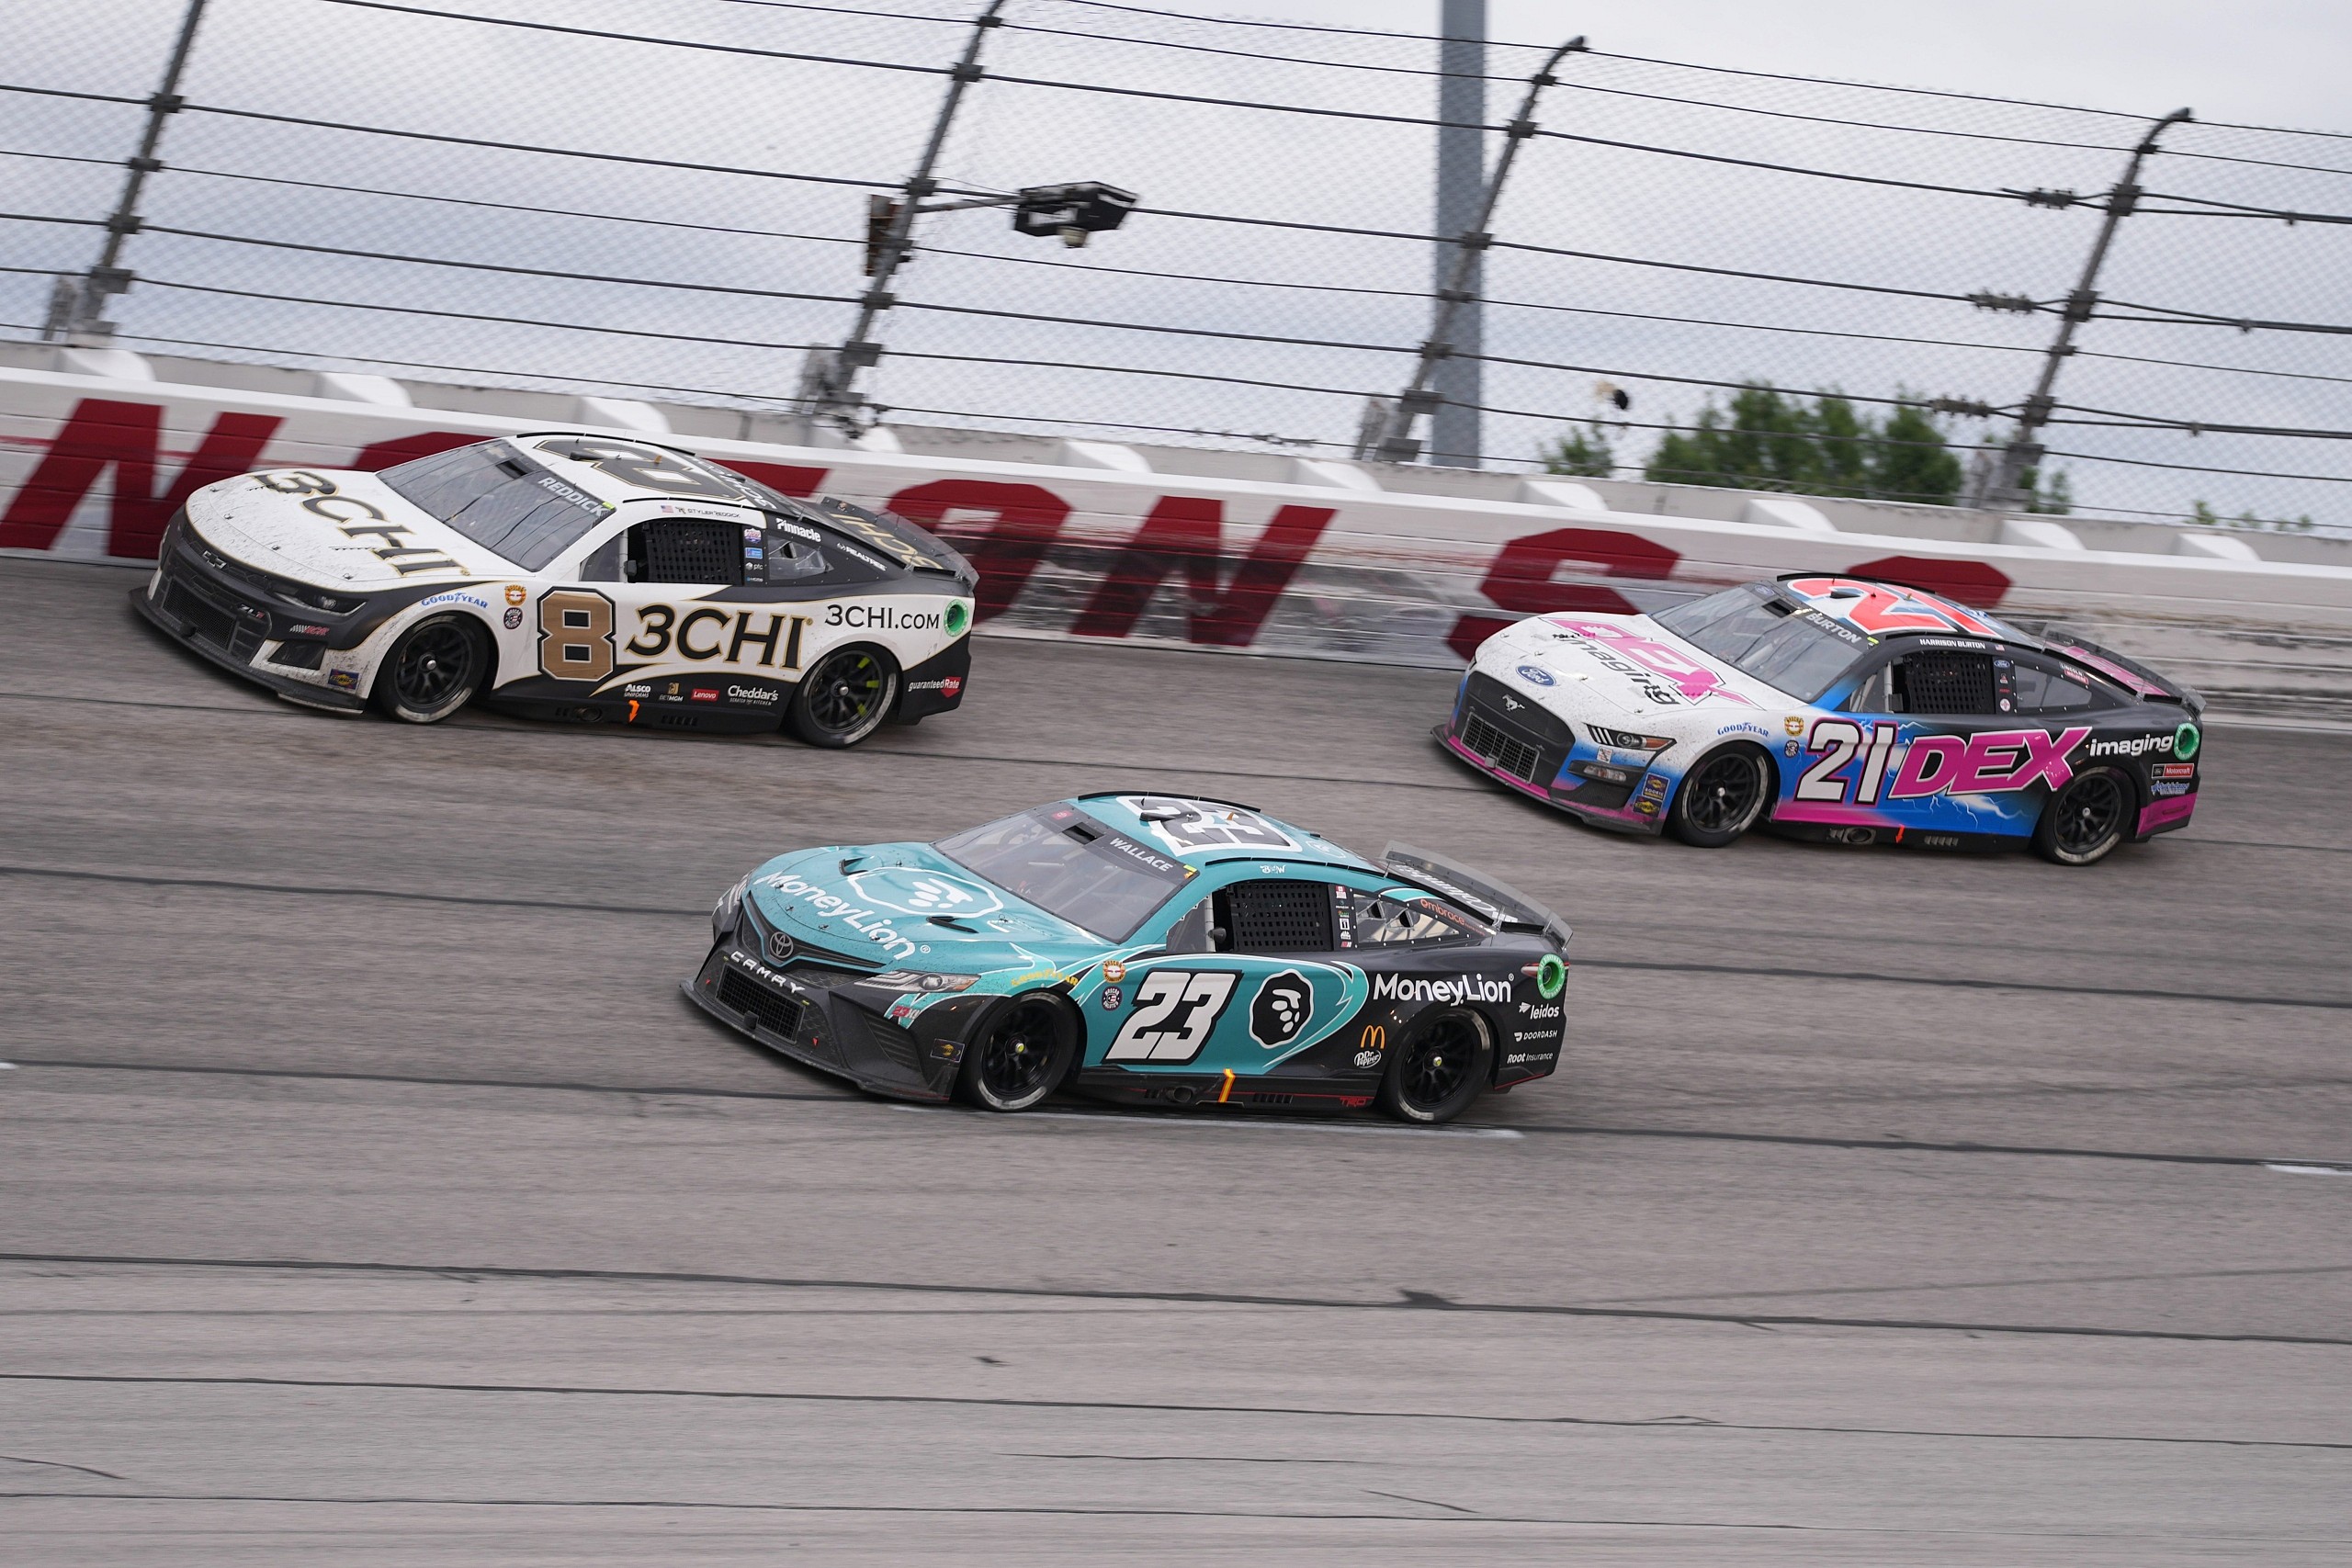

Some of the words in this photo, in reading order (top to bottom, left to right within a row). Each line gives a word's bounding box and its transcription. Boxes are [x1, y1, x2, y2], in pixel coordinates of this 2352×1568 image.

[537, 477, 609, 516] REDDICK
[248, 470, 469, 577] 3CHI
[775, 517, 821, 543] Pinnacle
[844, 546, 887, 571] REALTREE
[421, 592, 488, 608] GOODYEAR
[1787, 578, 2005, 640] 21
[825, 604, 940, 629] 3CHI.COM
[1806, 613, 1861, 643] BURTON
[537, 587, 616, 682] 8
[624, 603, 808, 671] 3CHI
[1919, 638, 1957, 648] HARRISON
[1957, 641, 1985, 649] BURTON
[625, 683, 650, 693] ALSCO
[659, 694, 684, 702] BETMGM
[693, 691, 717, 699] Lenovo
[728, 684, 779, 702] Cheddar's
[1717, 722, 1770, 738] GOODYEAR
[2089, 734, 2174, 757] imaging
[1795, 718, 1897, 806] 21
[1888, 727, 2093, 798] DEX
[2165, 766, 2191, 775] Motorcraft
[1109, 837, 1173, 872] WALLACE
[753, 872, 916, 961] MoneyLion
[1420, 898, 1465, 924] embrace
[730, 951, 806, 994] CAMRY
[1373, 973, 1511, 1007] MoneyLion
[1105, 969, 1240, 1063] 23
[1530, 1002, 1559, 1020] leidos
[1523, 1030, 1557, 1040] DOORDASH
[1526, 1052, 1553, 1062] Insurance
